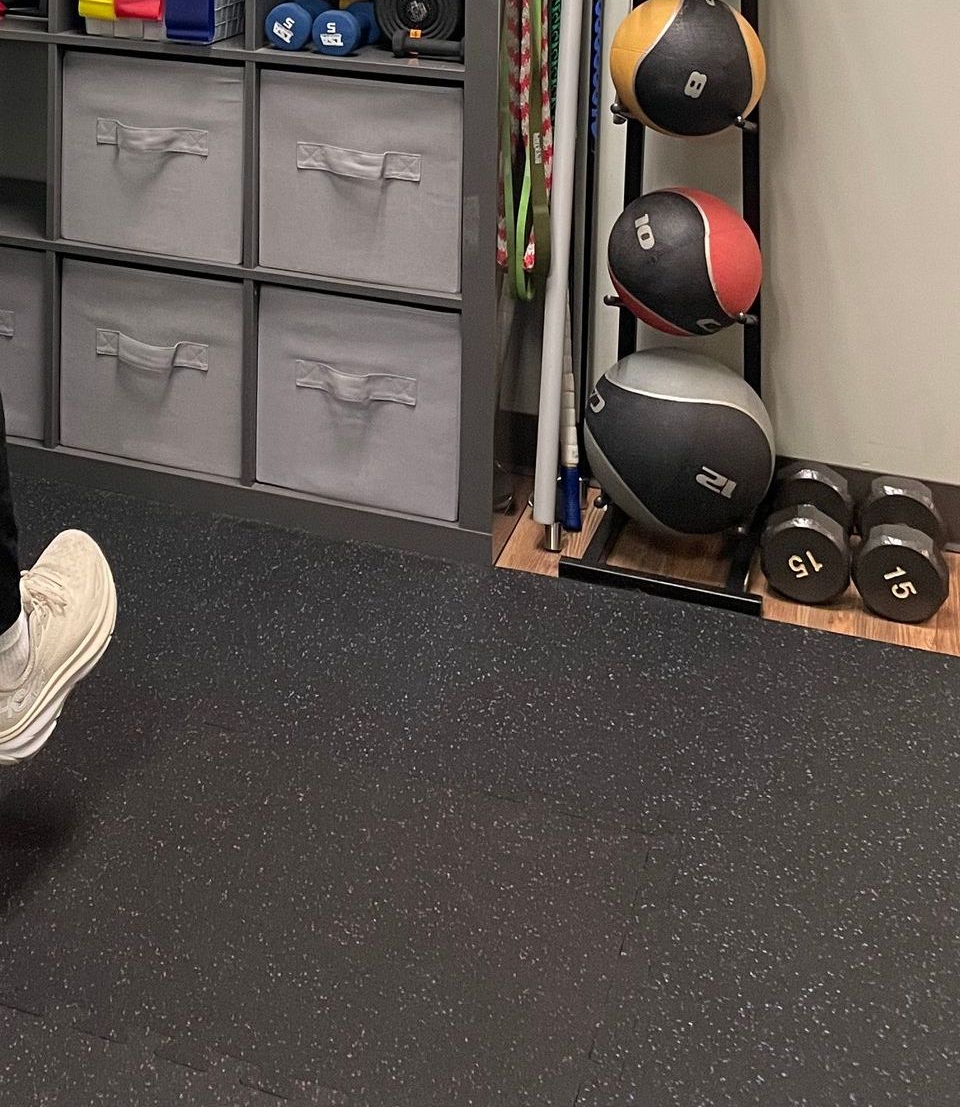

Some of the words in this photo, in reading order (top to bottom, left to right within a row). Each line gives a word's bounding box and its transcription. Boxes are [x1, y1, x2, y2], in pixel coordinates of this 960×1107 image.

[283, 17, 295, 30] 5
[326, 22, 336, 33] 5
[684, 71, 707, 99] 8
[634, 213, 655, 250] 10
[695, 465, 737, 499] 12
[788, 550, 823, 579] 15
[883, 566, 917, 599] 15
